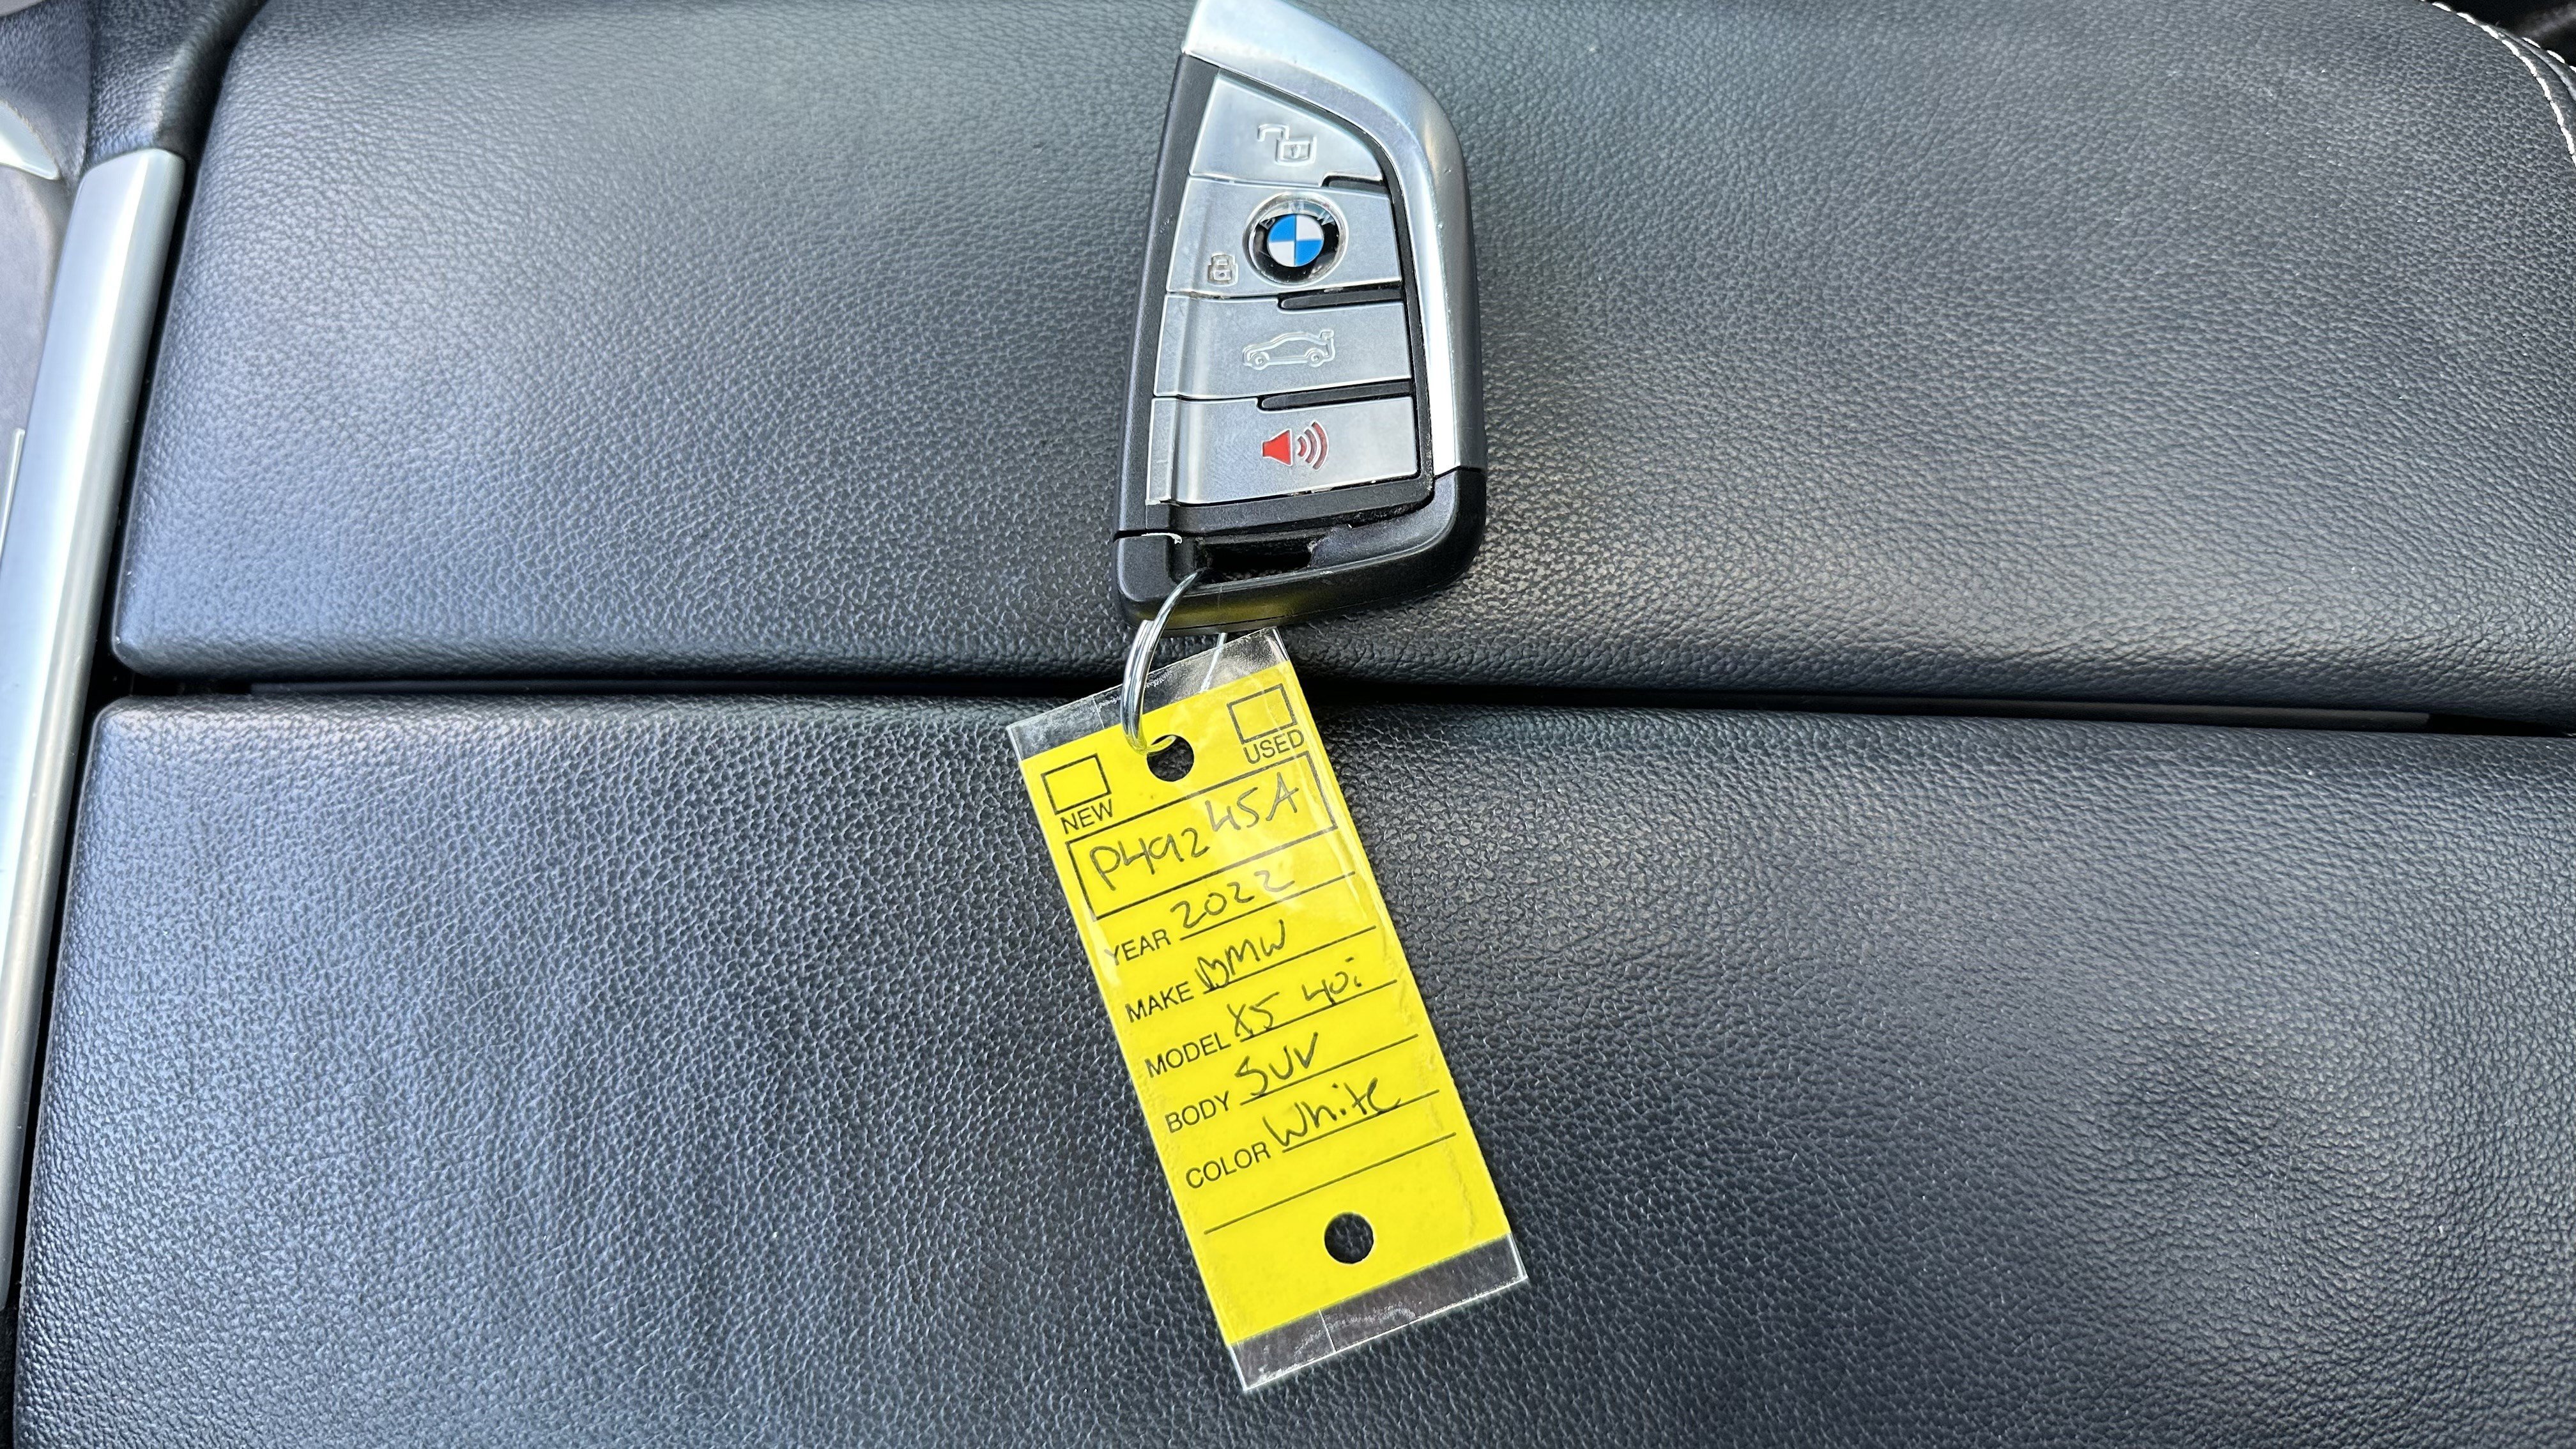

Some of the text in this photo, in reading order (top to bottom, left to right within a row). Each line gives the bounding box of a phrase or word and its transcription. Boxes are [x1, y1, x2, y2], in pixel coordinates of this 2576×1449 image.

[1260, 201, 1335, 230] BMW
[1242, 728, 1305, 764] USED
[1061, 799, 1115, 834] NEW
[1105, 869, 1296, 968] YEAR 2022
[1124, 919, 1287, 1023] MAKE BMW
[1144, 1032, 1231, 1078] MODEL
[1228, 992, 1280, 1038] X5
[1164, 1032, 1319, 1133] BODY SUV
[1186, 1077, 1401, 1190] COLOR White
